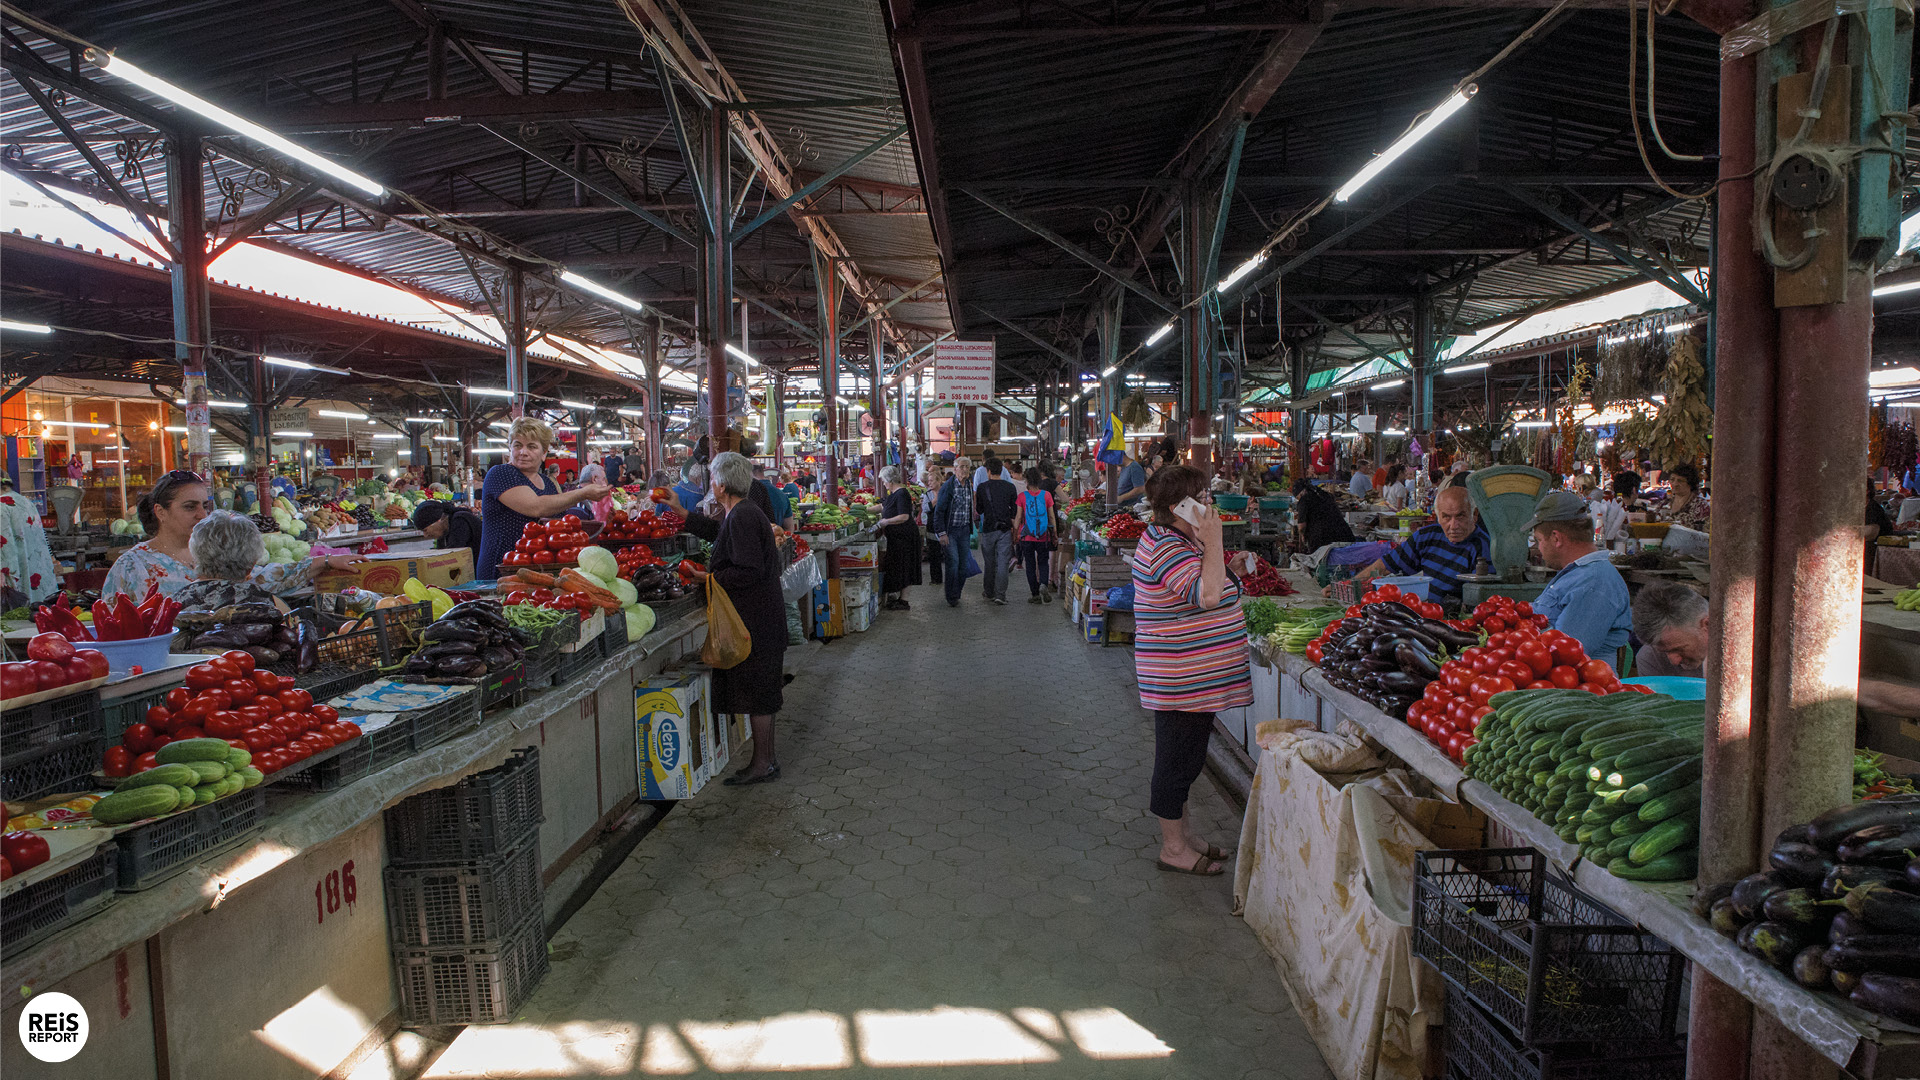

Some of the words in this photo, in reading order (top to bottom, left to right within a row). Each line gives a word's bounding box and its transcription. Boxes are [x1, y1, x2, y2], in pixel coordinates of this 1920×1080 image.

[90, 412, 99, 436] 5
[659, 722, 679, 767] derby
[315, 860, 356, 924] 186
